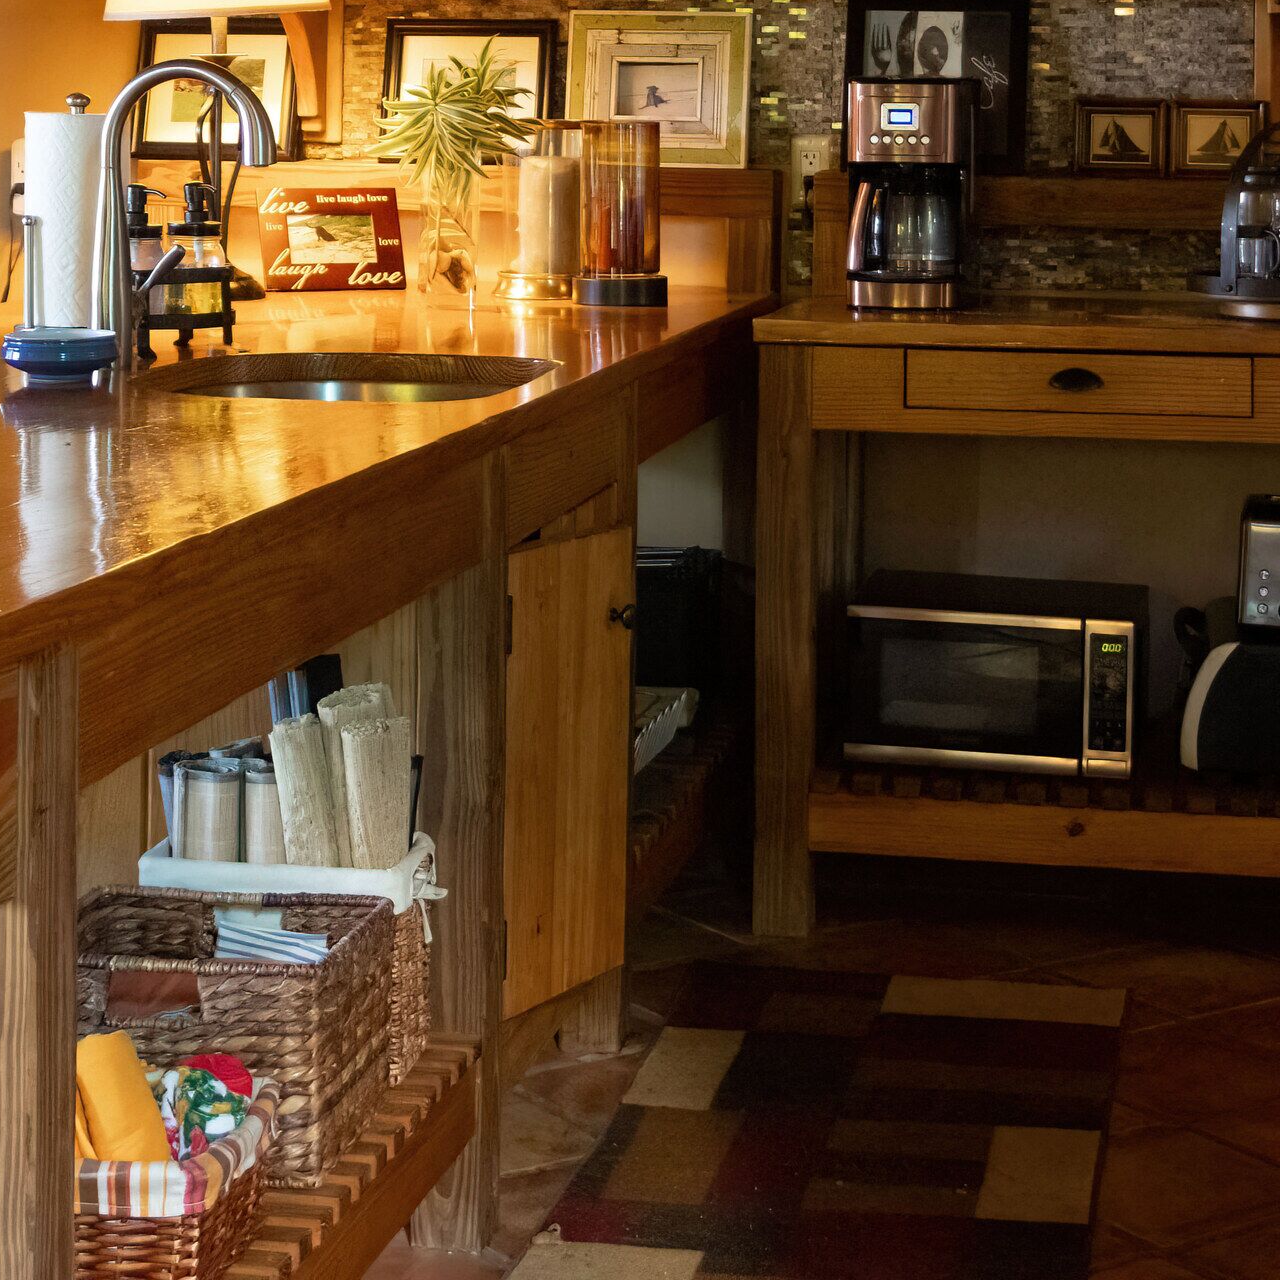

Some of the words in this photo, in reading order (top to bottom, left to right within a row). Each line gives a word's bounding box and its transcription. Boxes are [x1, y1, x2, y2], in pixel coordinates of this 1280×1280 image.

[259, 187, 310, 215] live
[315, 194, 336, 204] live
[336, 194, 366, 204] laugh
[366, 194, 389, 203] love
[265, 221, 284, 231] live
[378, 236, 400, 247] love
[268, 248, 329, 291] laugh
[347, 261, 404, 286] love
